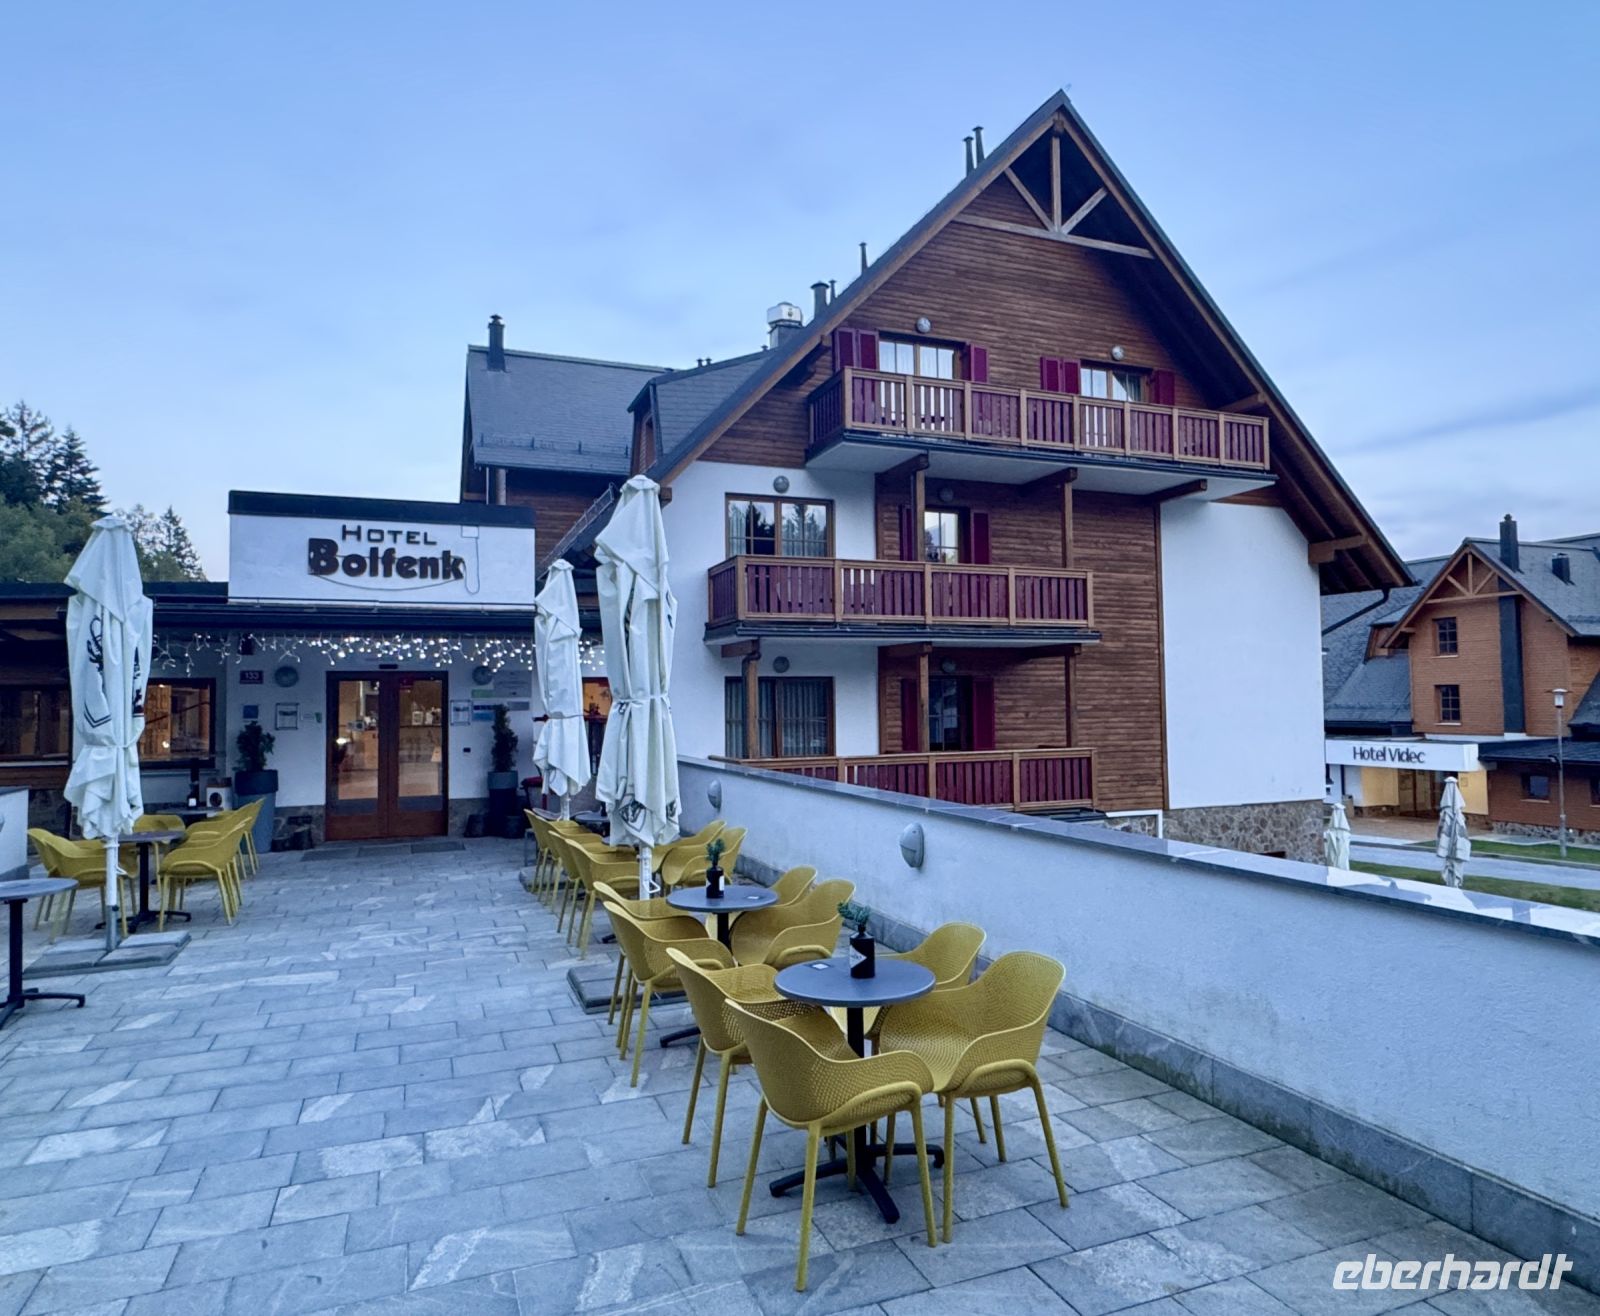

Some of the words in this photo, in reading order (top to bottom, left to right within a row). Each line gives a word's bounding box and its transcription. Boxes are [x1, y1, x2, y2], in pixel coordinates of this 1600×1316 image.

[340, 524, 438, 546] HOTEL
[308, 538, 464, 579] Bolfenk
[245, 671, 260, 680] 133
[1353, 746, 1386, 761] Hotel
[1388, 747, 1426, 763] Videc
